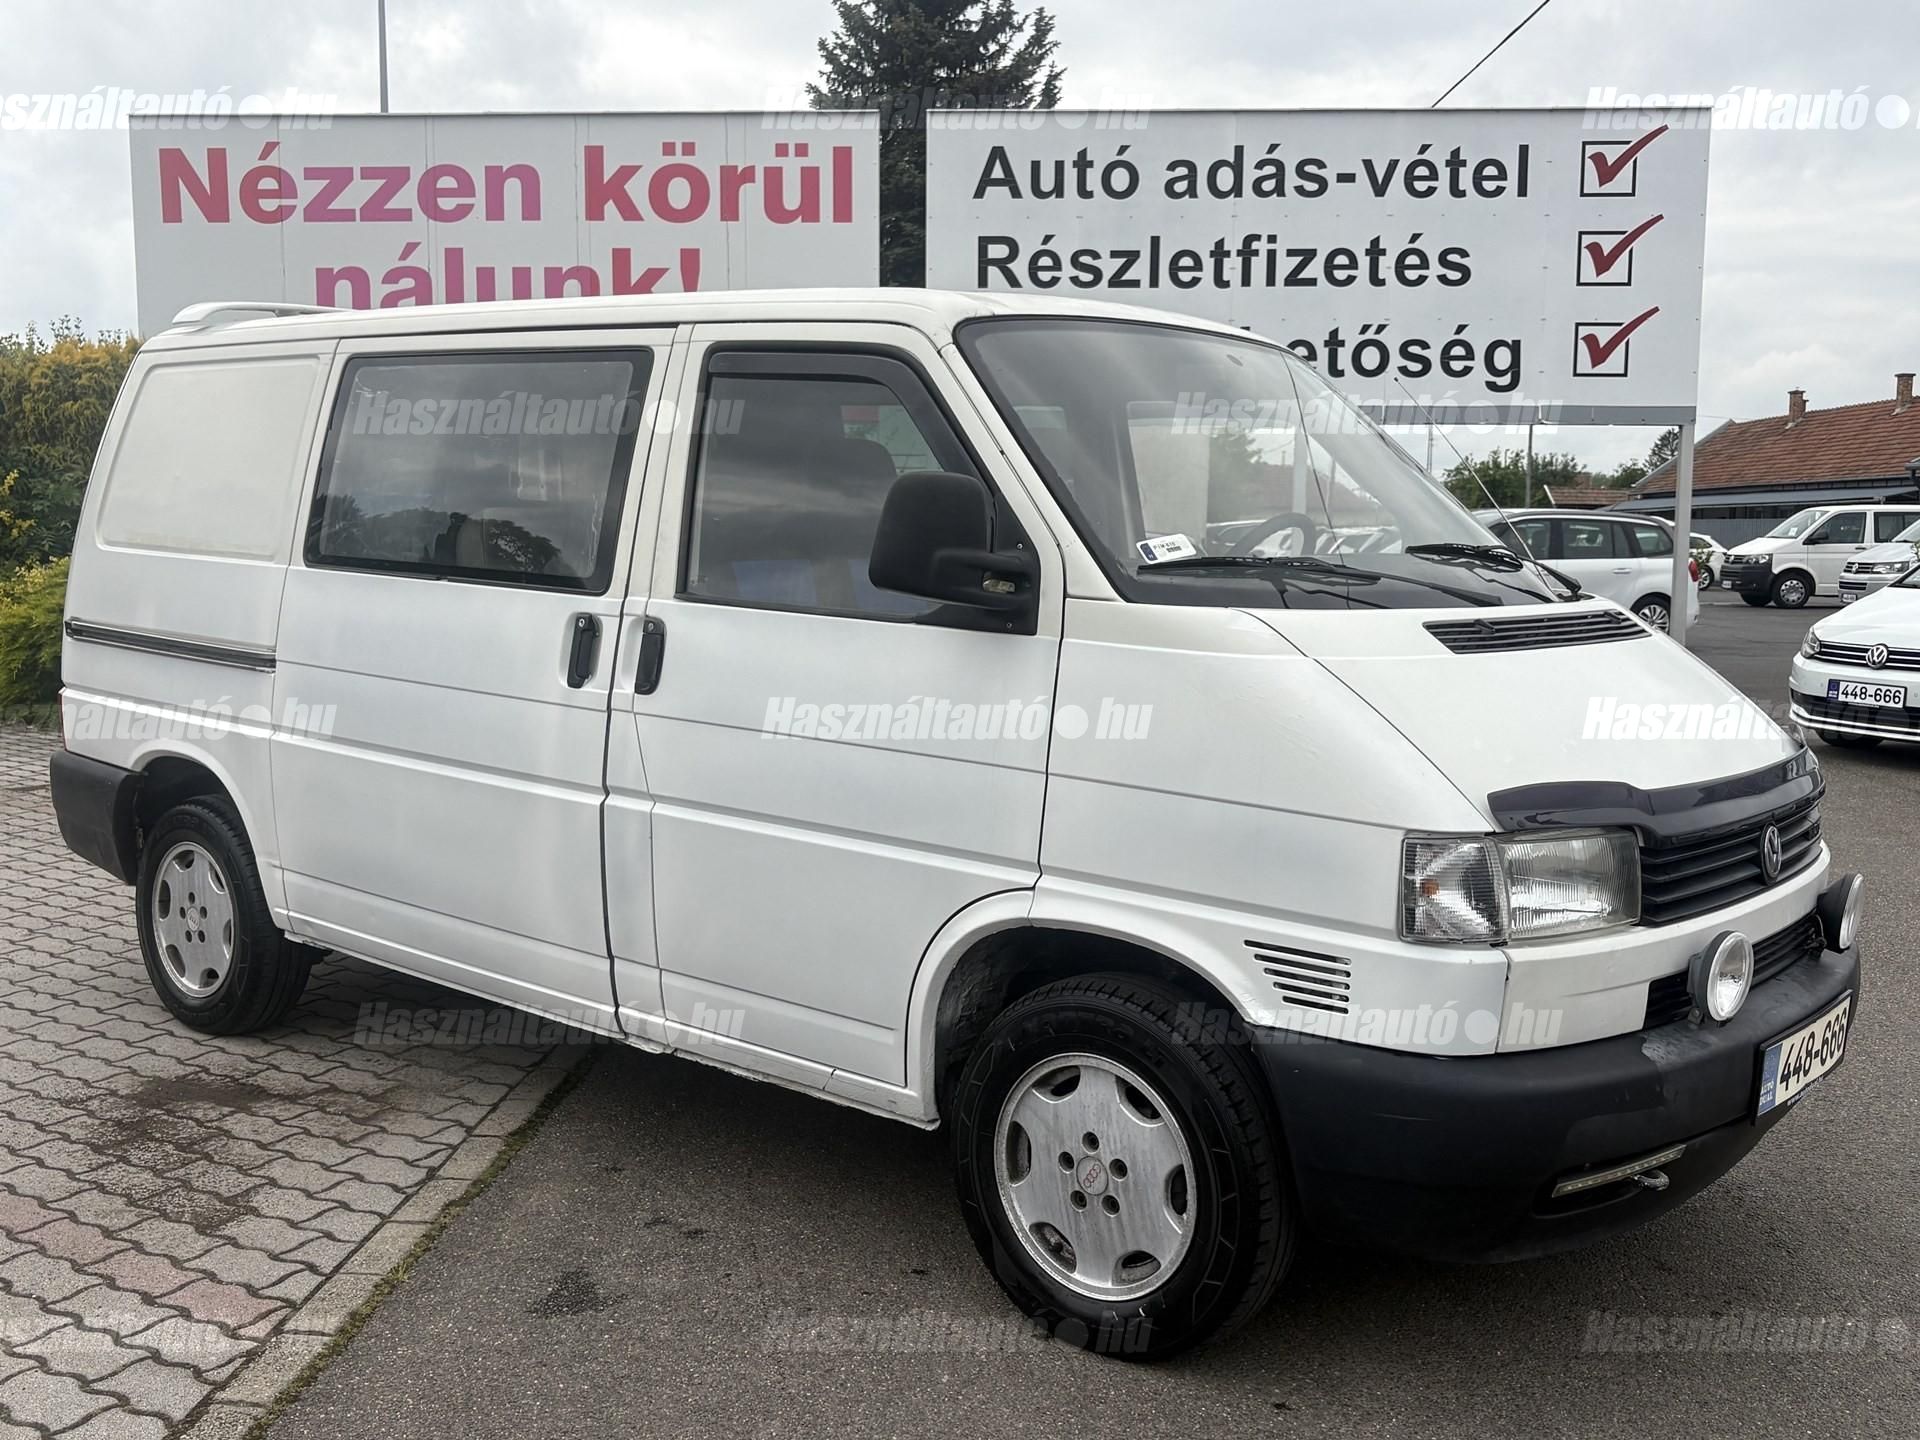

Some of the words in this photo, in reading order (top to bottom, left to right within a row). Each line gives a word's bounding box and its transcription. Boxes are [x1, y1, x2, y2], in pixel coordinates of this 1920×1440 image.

[158, 141, 542, 224] Nézzen
[583, 141, 853, 224] körül
[972, 144, 1140, 200] Autó
[1164, 143, 1530, 199] adás-vétel
[976, 232, 1472, 288] Részletfizetés
[1285, 324, 1522, 393] etőség
[1841, 684, 1902, 705] 448-666
[1779, 1007, 1847, 1091] 448-666
